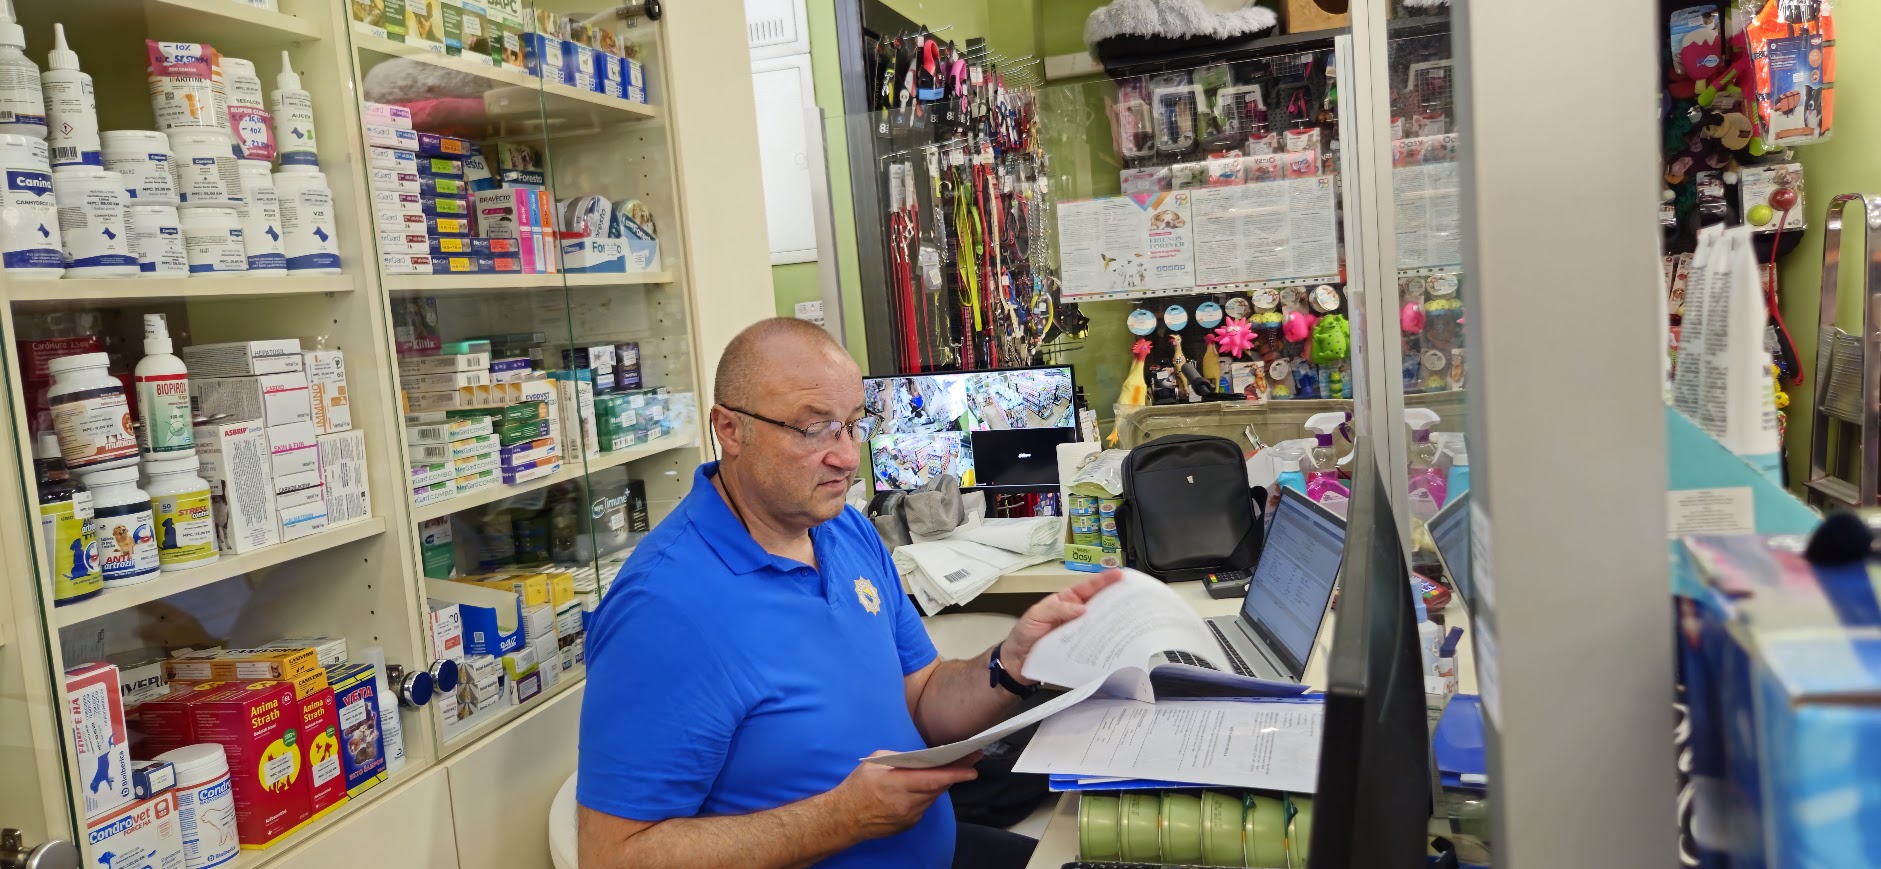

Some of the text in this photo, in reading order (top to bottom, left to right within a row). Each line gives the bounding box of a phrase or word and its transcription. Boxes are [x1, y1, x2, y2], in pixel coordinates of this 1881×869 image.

[16, 176, 52, 189] Canina
[518, 173, 543, 183] Foresto
[479, 193, 512, 204] BRAVECTO
[1149, 236, 1182, 244] FRIENDS
[1149, 241, 1185, 249] FOREVER
[32, 341, 67, 350] Cardisure
[311, 383, 322, 428] IMMUNO
[224, 426, 248, 437] ASBRIP
[273, 444, 288, 452] SKIN
[293, 441, 305, 449] FUR
[453, 442, 498, 456] NexGard COMBO
[455, 459, 499, 473] NexGard COMBO
[428, 470, 453, 481] COMBO
[456, 476, 500, 491] NexGard COMBO
[430, 489, 454, 500] COMBO
[178, 505, 207, 516] STRESS
[106, 553, 131, 564] ANTI
[1072, 551, 1093, 563] Oasy
[288, 650, 315, 664] CANIVERM
[298, 671, 324, 687] CANIVERM
[342, 685, 374, 707] VETA
[250, 698, 279, 718] Anima
[303, 699, 324, 715] Anima
[251, 709, 281, 730] Strath
[303, 708, 325, 724] Strath
[118, 750, 128, 787] Bioiberica
[88, 806, 151, 844] Condrovet
